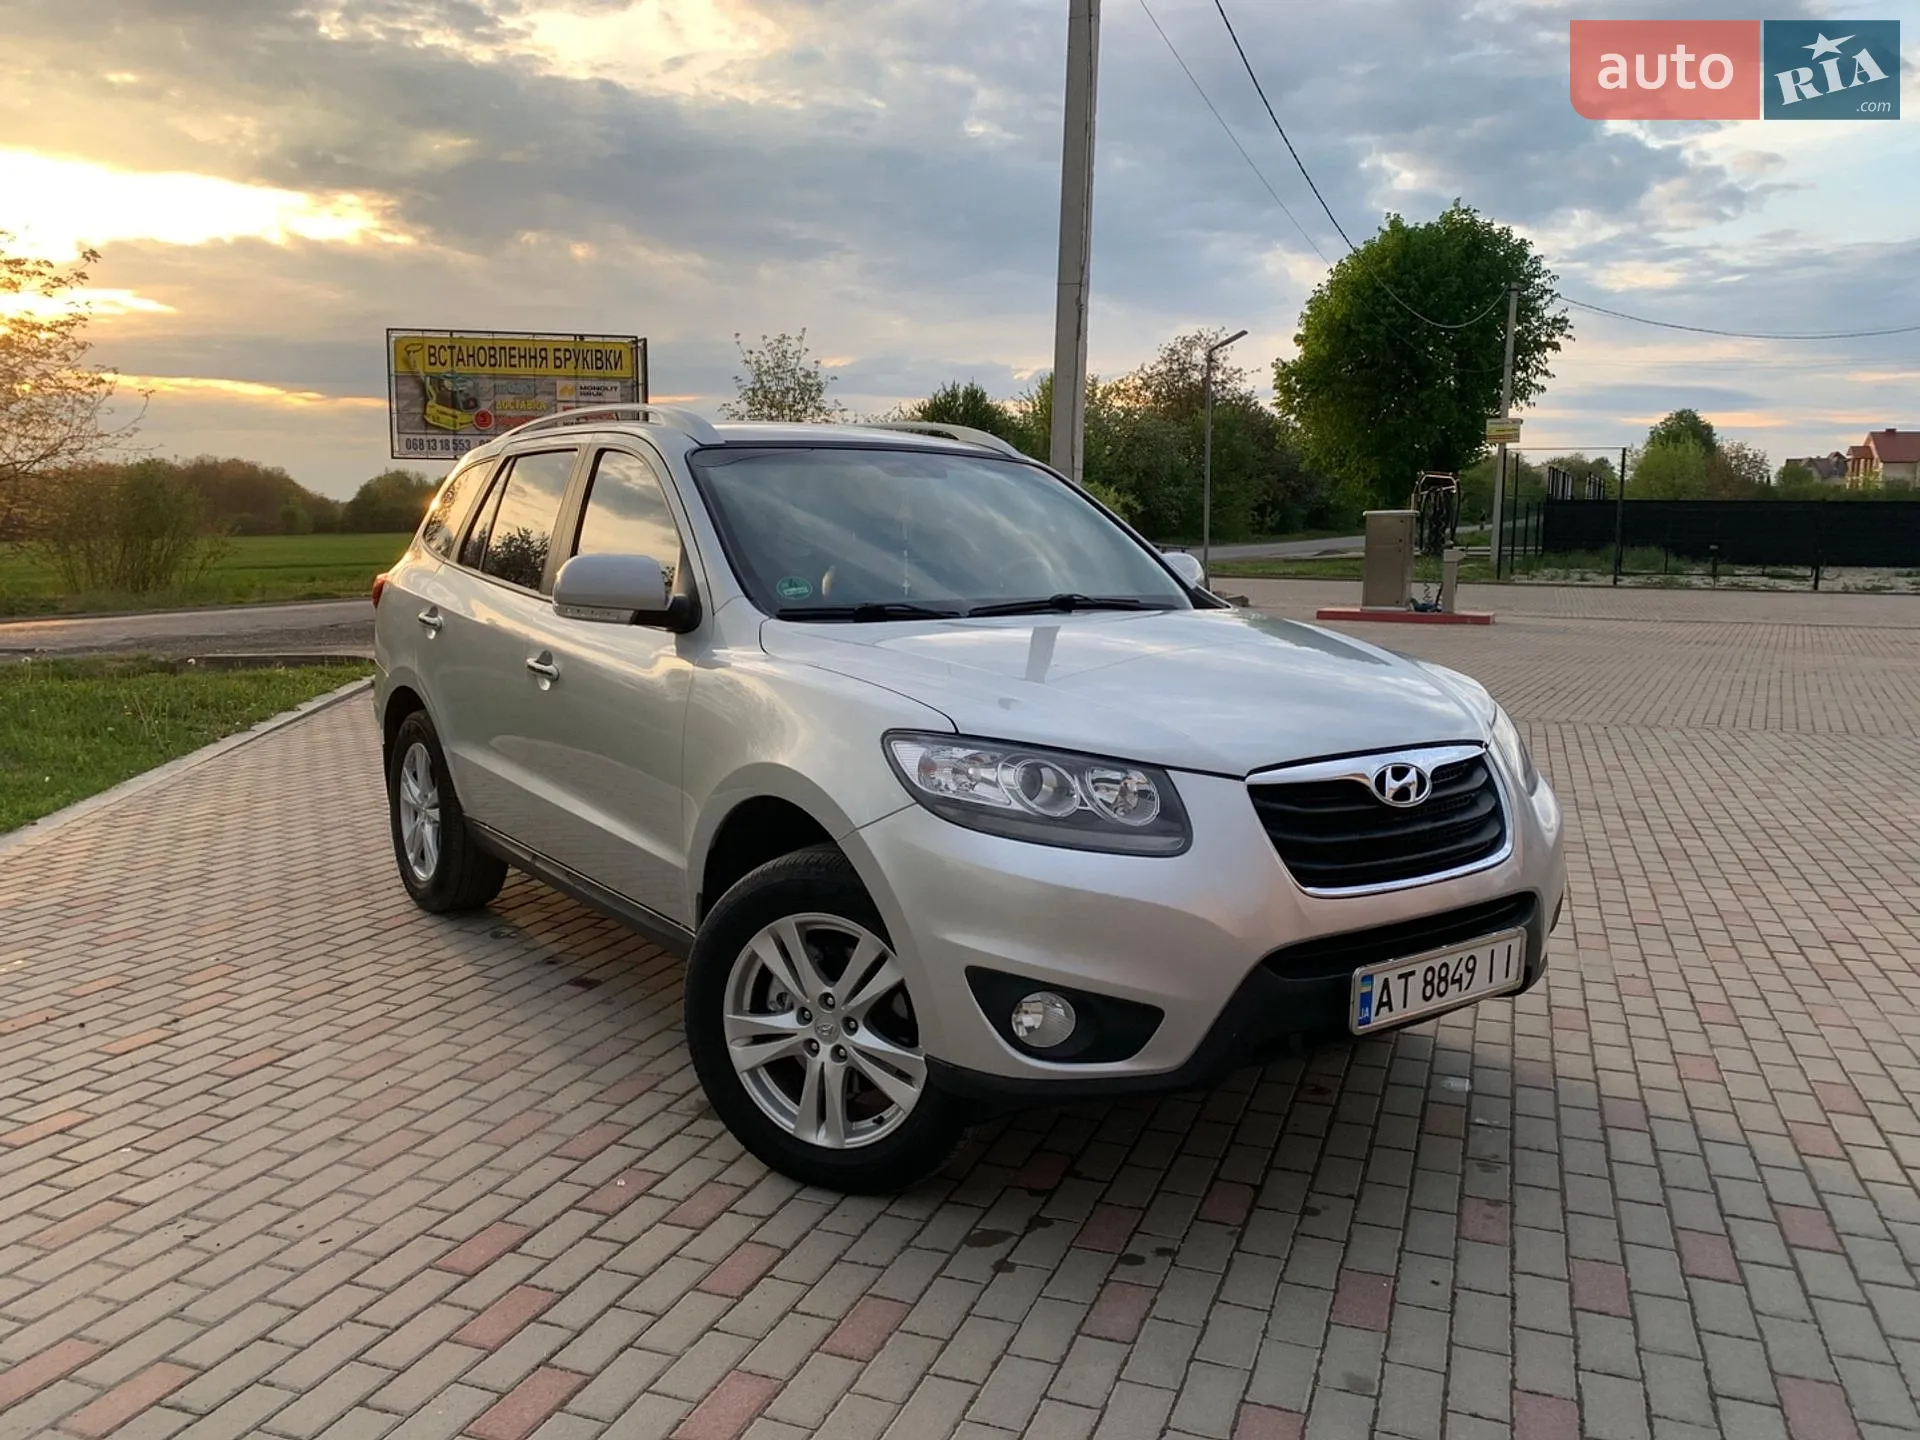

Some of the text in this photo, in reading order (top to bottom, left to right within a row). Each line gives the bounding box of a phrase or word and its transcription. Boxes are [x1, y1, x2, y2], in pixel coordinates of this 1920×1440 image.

[427, 344, 623, 371] ВСТАНОВЛЕННЯ БРУКІВКИ
[405, 438, 424, 451] 068
[427, 438, 438, 451] 13
[1374, 969, 1416, 1017] AT
[1422, 954, 1477, 1002] 8849
